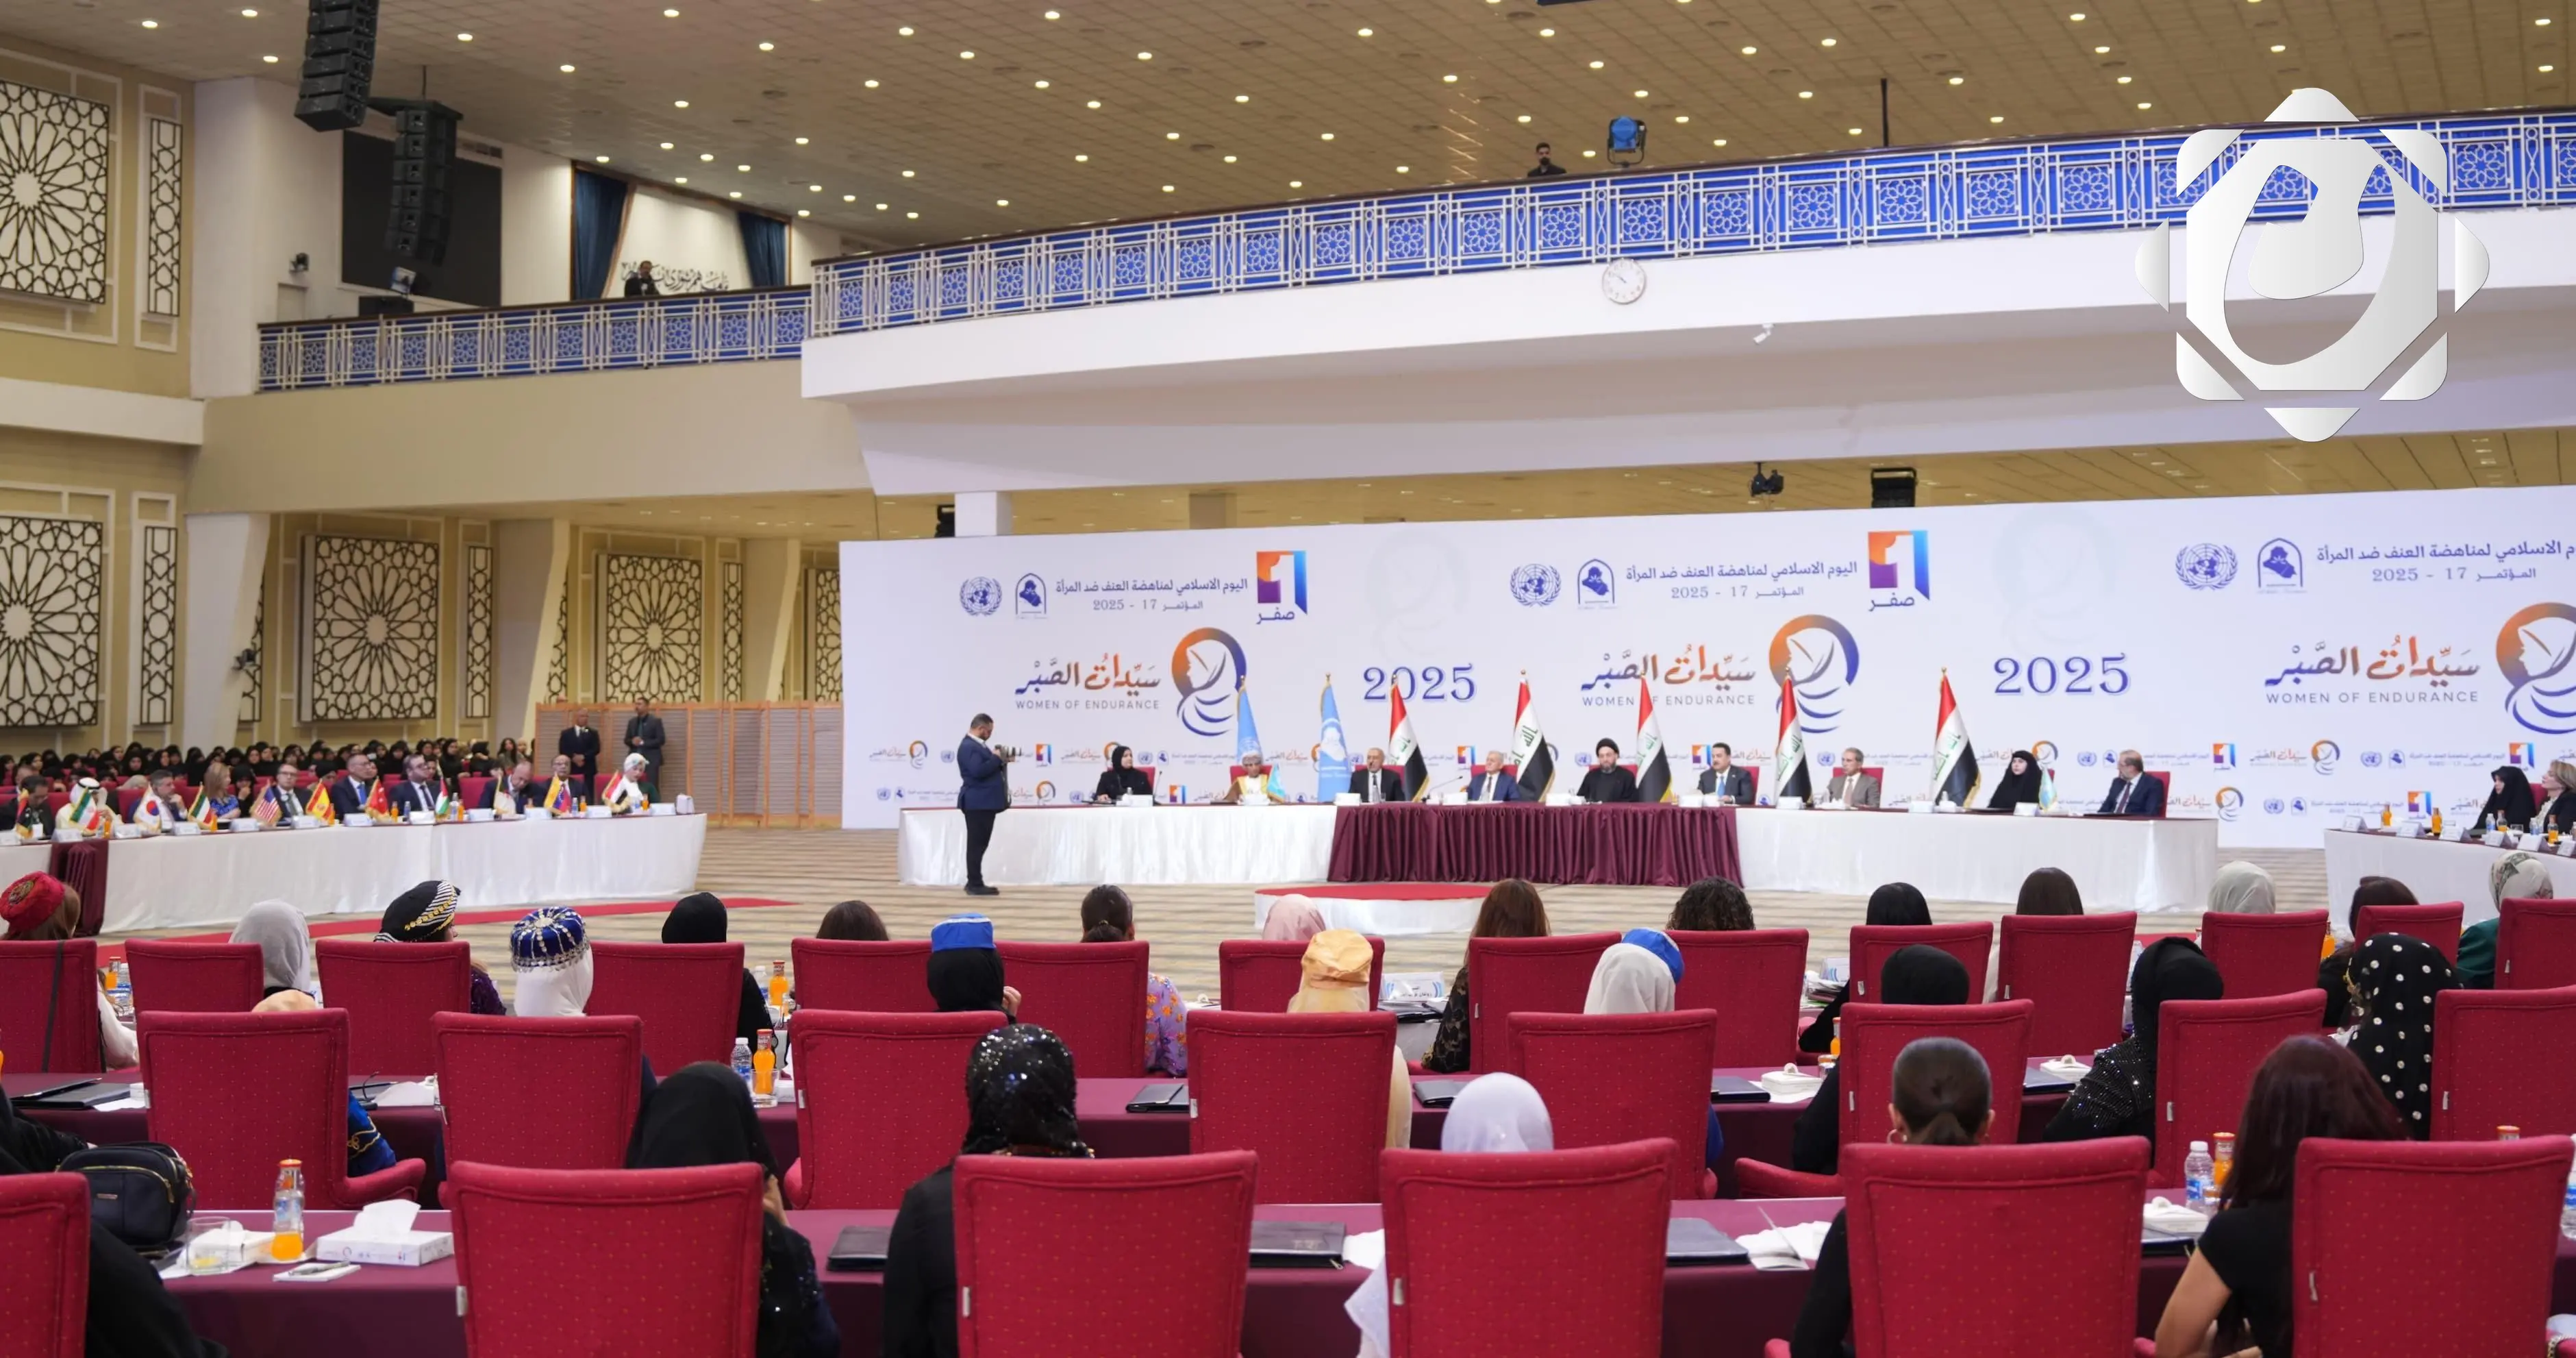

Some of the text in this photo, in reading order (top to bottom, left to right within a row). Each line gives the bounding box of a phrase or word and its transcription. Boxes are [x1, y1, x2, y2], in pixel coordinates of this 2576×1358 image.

[2317, 545, 2354, 564] المرأة
[2358, 547, 2380, 559] ضد
[2384, 545, 2425, 558] العنف
[2429, 543, 2491, 557] لمناهضة
[2495, 539, 2562, 563] الاسلامي
[1626, 561, 1858, 582] اليوم الاسلامي لمناهضة العنف ضد المرأة
[2373, 568, 2418, 582] 2025
[2447, 567, 2467, 580] 17
[2476, 568, 2536, 582] المؤتمر
[1055, 578, 1248, 596] اليوم الاسلامي لمناهضة العنف ضد المرأة
[1671, 587, 1708, 599] 2025
[1731, 585, 1748, 597] 17
[1755, 587, 1804, 600] المؤتمر
[1093, 599, 1124, 610] 2025
[1143, 599, 1158, 610] 17
[1162, 600, 1203, 611] المؤتمر
[1868, 595, 1916, 612] صفر
[1255, 609, 1296, 625] صفر
[1993, 652, 2129, 695] 2025
[1363, 663, 1475, 700] 2025
[1582, 695, 1634, 706] WOMEN
[1666, 695, 1754, 705] ENDURANCE
[2266, 691, 2478, 704] WOMEN OF ENDURANCE
[1016, 700, 1159, 710] WOMEN OF ENDURANCE
